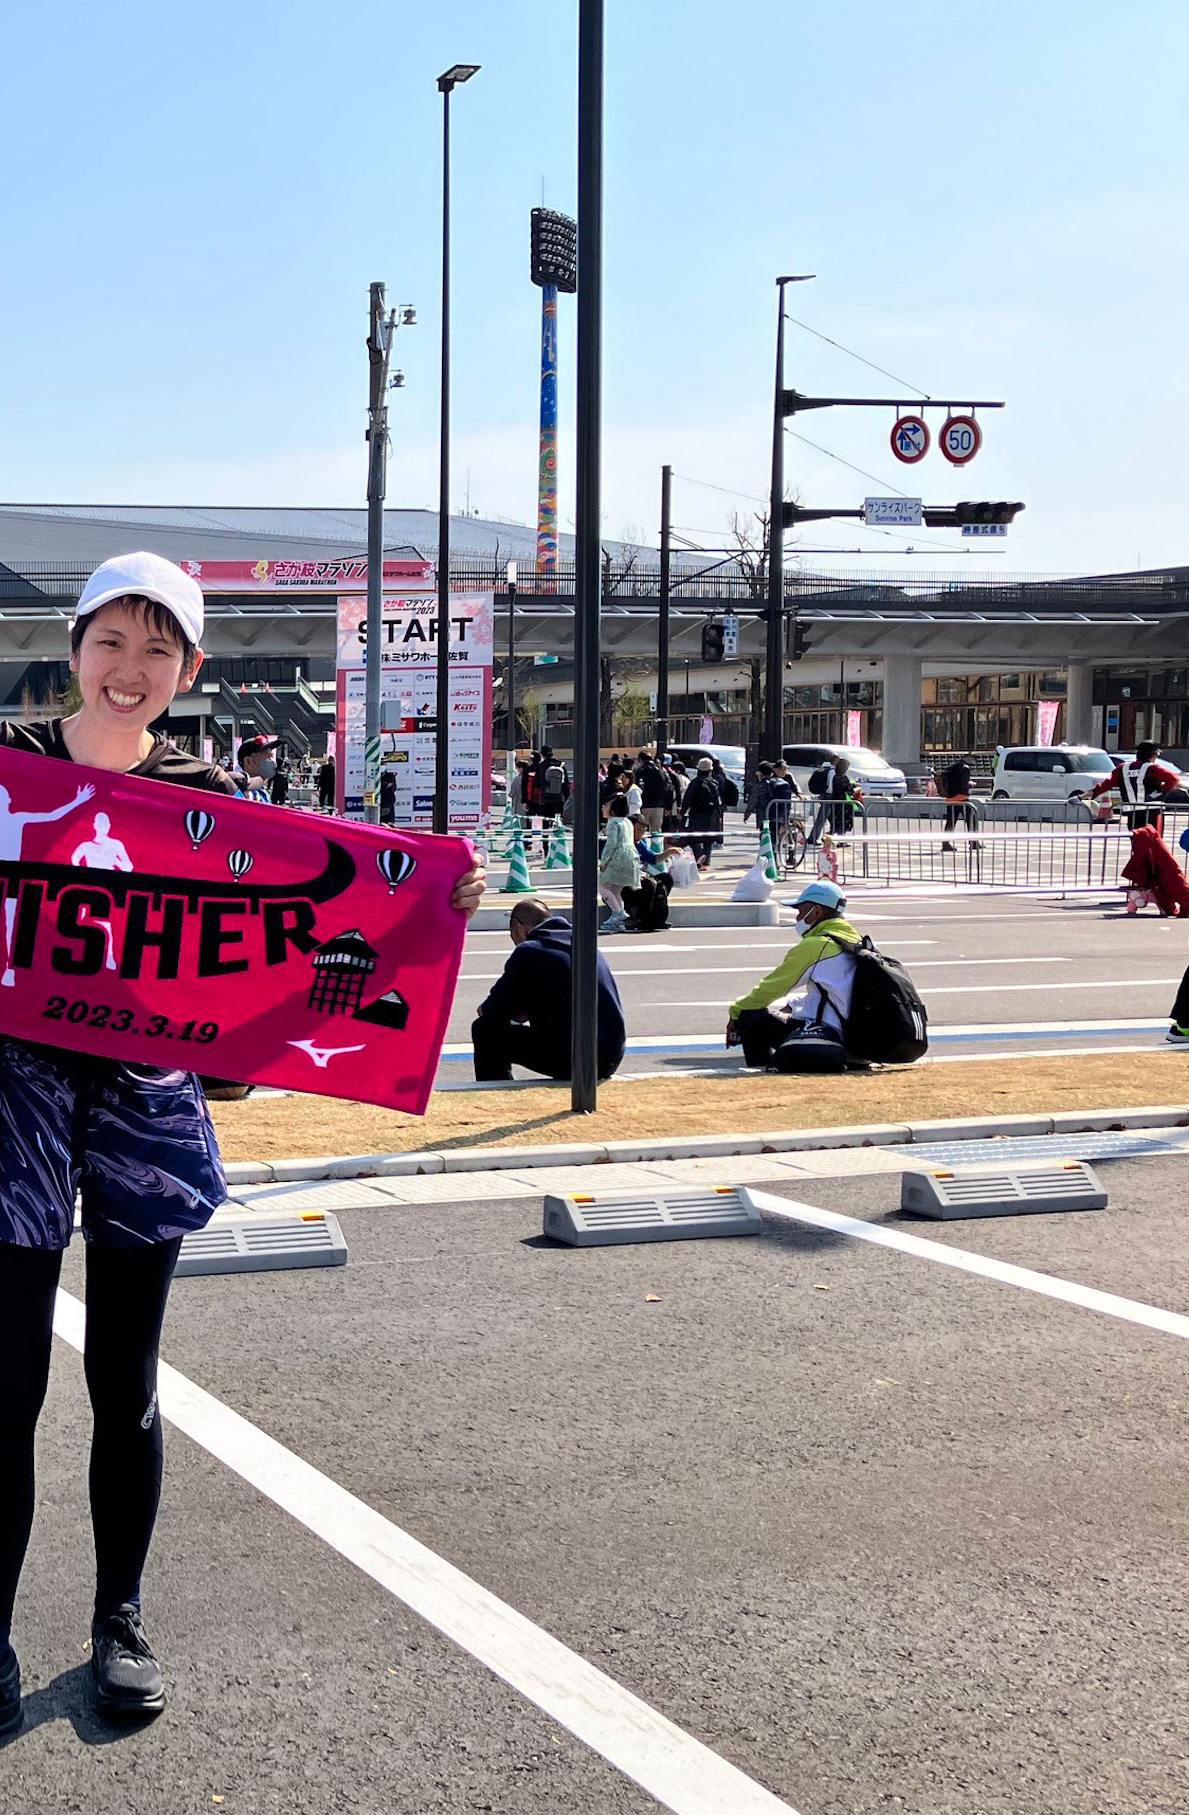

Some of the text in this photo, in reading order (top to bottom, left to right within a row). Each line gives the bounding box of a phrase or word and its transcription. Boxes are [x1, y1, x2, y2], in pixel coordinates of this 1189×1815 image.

[949, 430, 972, 450] 50
[868, 502, 920, 513] サンライズパーク
[875, 514, 897, 522] Sunrise
[416, 606, 435, 614] 2023
[42, 996, 219, 1044] 2023.3.19
